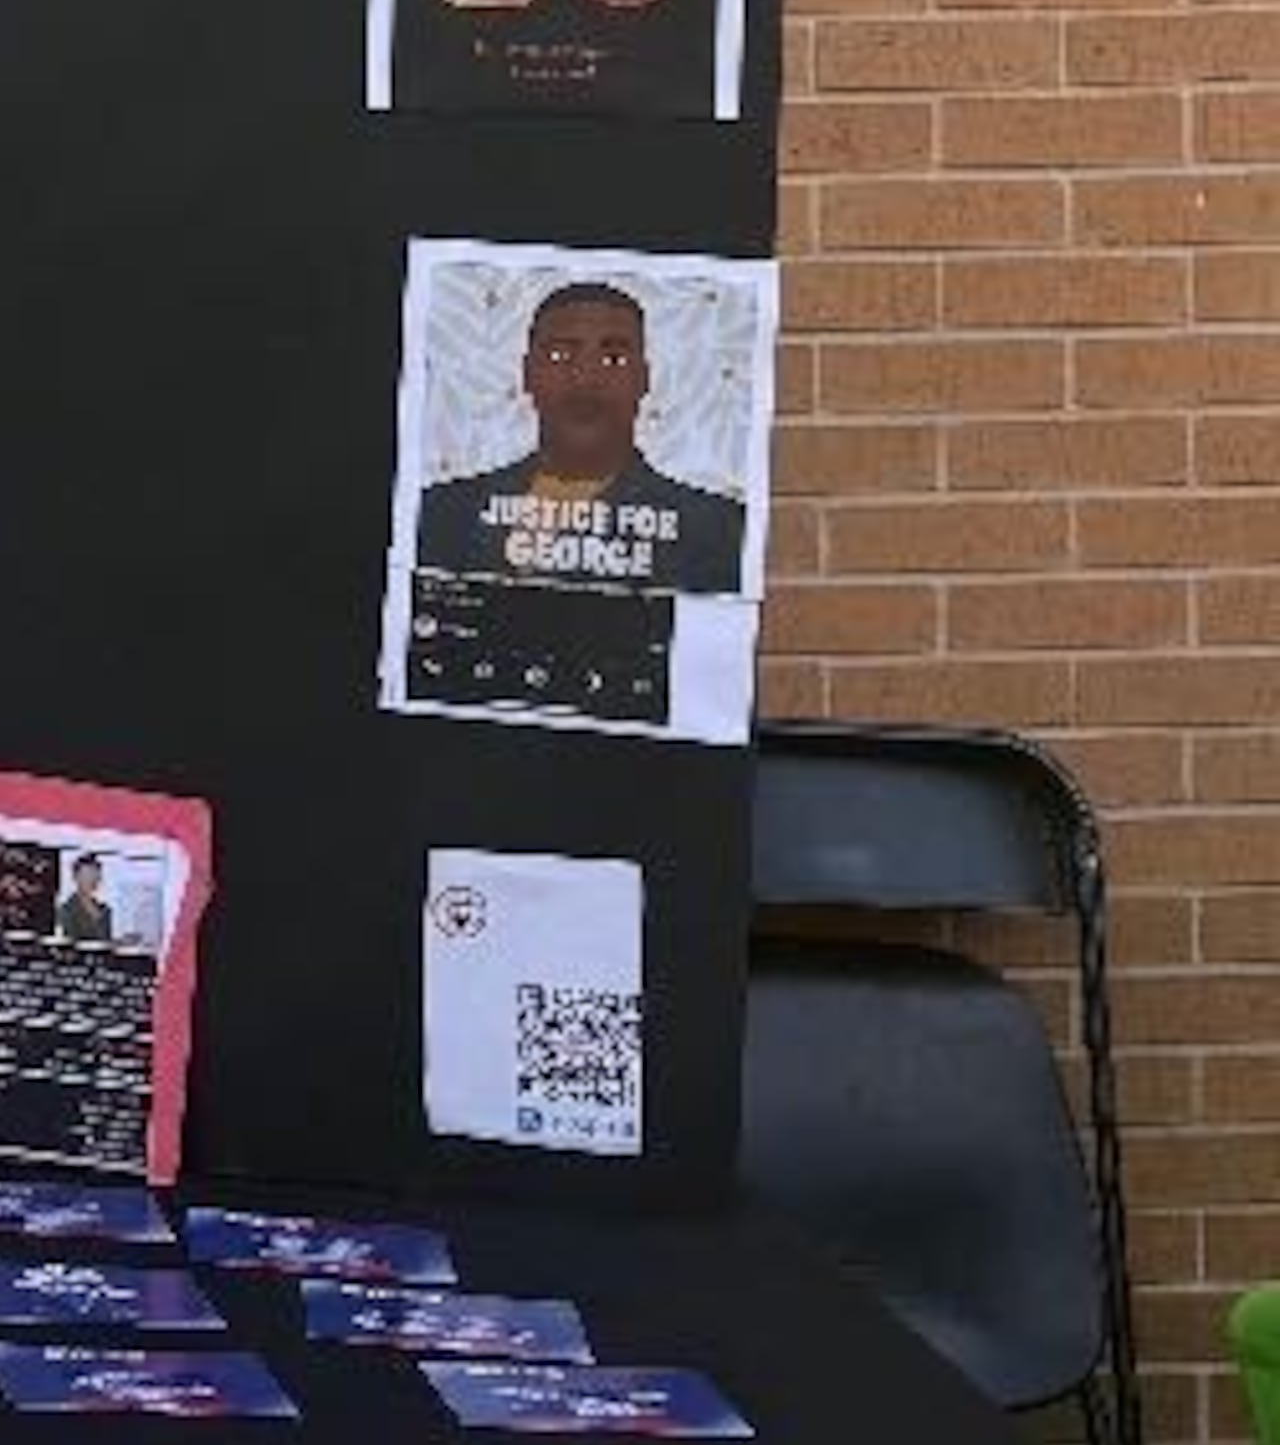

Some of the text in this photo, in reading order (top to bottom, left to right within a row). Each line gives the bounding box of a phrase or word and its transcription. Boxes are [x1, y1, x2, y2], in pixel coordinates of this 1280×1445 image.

[479, 495, 680, 541] JUSTICE FOR
[505, 533, 654, 577] GEORGE
